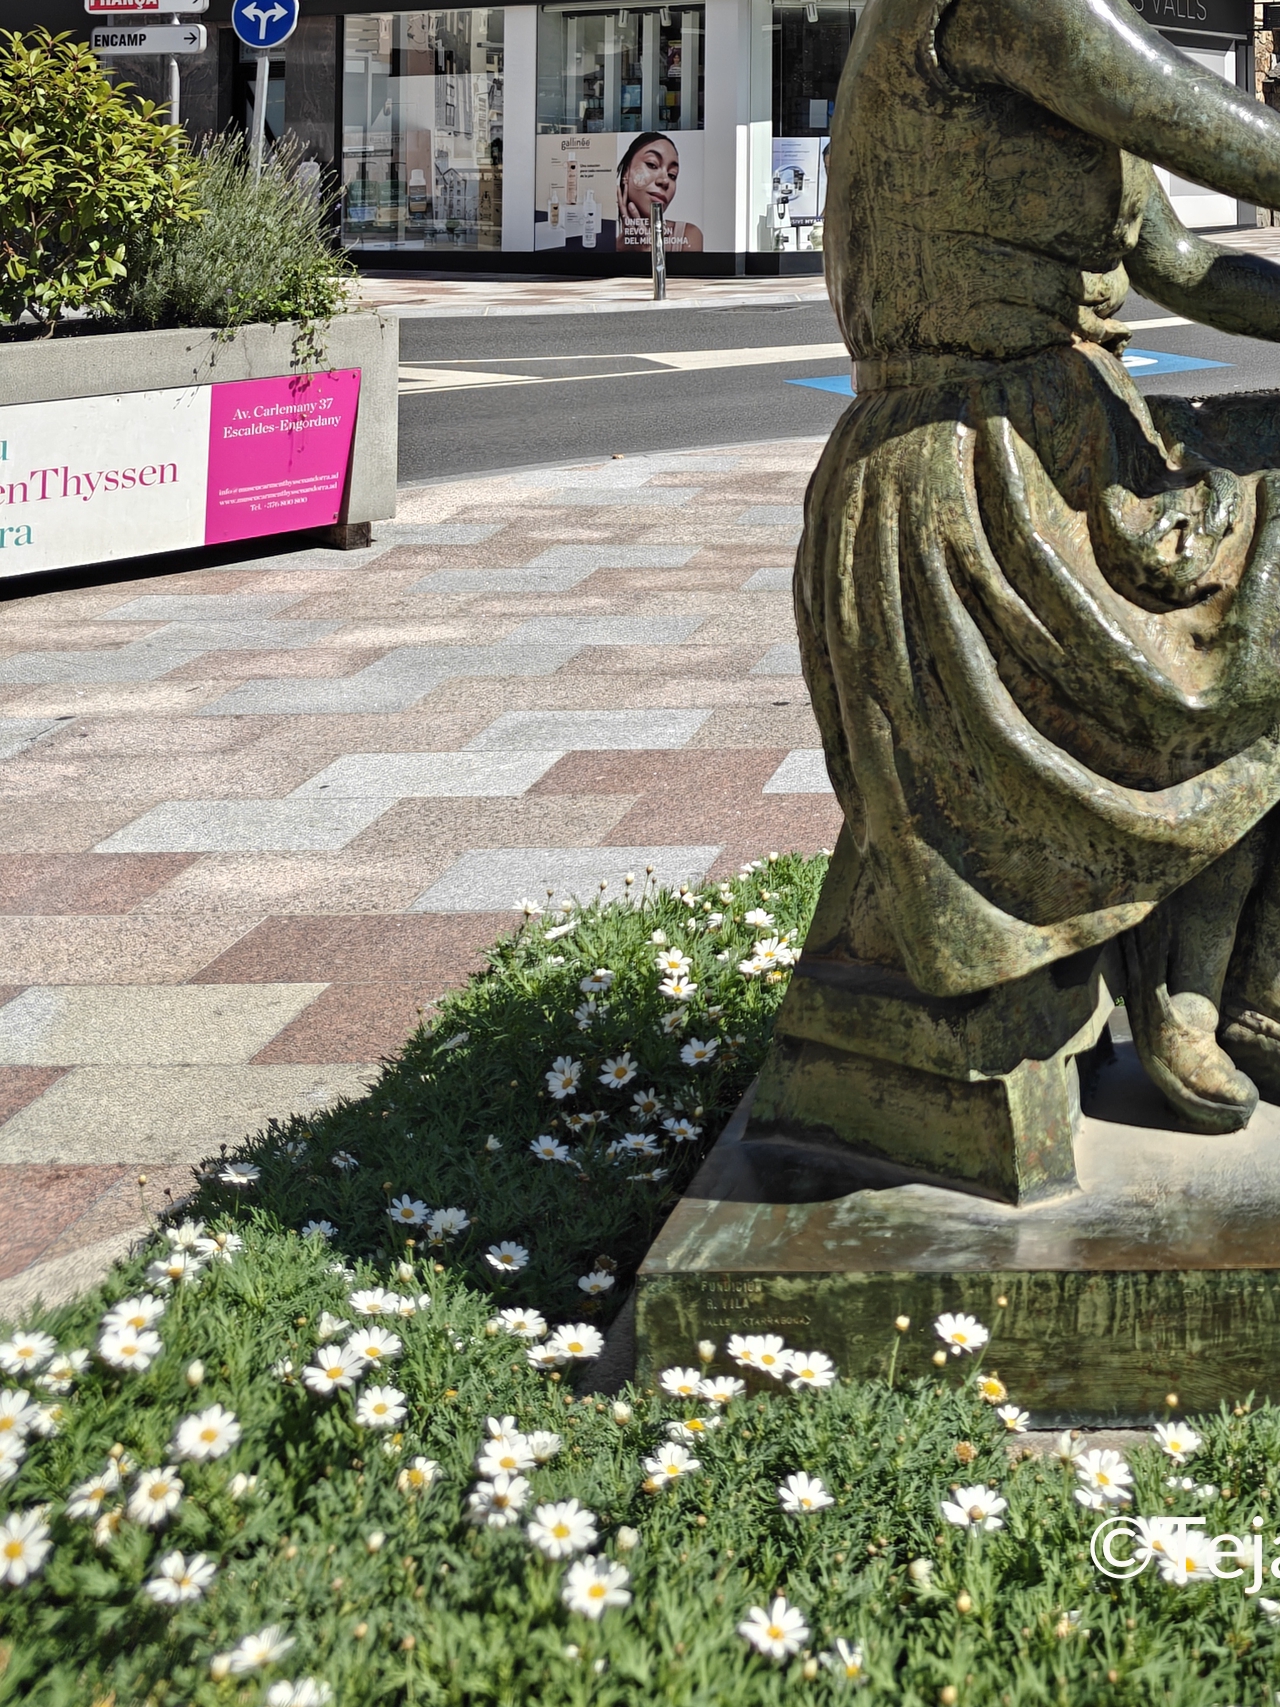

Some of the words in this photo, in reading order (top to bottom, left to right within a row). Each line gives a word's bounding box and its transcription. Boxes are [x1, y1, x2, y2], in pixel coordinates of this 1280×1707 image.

[94, 33, 147, 47] ENCAMP
[624, 236, 640, 245] DEL
[232, 408, 251, 421] Av.
[253, 401, 318, 418] Carlemany
[318, 397, 334, 410] 37
[222, 414, 342, 439] Escaldes-Engordany
